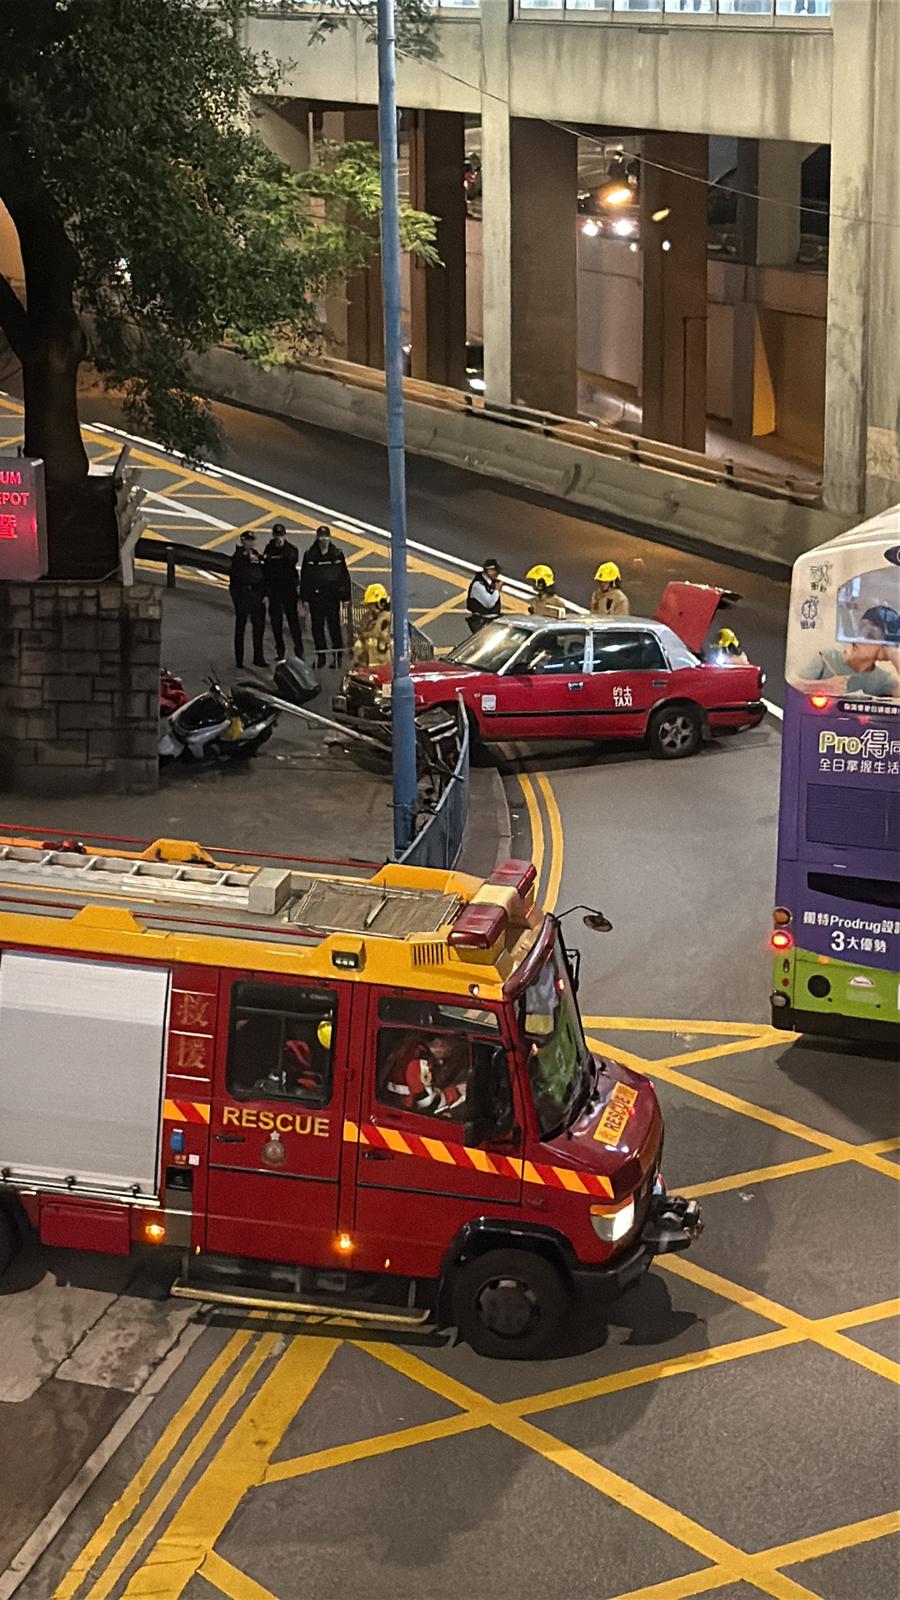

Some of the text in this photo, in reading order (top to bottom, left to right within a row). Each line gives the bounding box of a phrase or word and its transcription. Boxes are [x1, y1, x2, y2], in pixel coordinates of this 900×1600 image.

[0, 492, 30, 506] POT
[613, 685, 632, 697] 的士
[613, 696, 633, 707] TAXI
[819, 758, 899, 774] 全日掌握生活
[831, 931, 887, 953] 3大優勢
[603, 1094, 631, 1132] RESCUE
[223, 1106, 330, 1137] RESCUE
